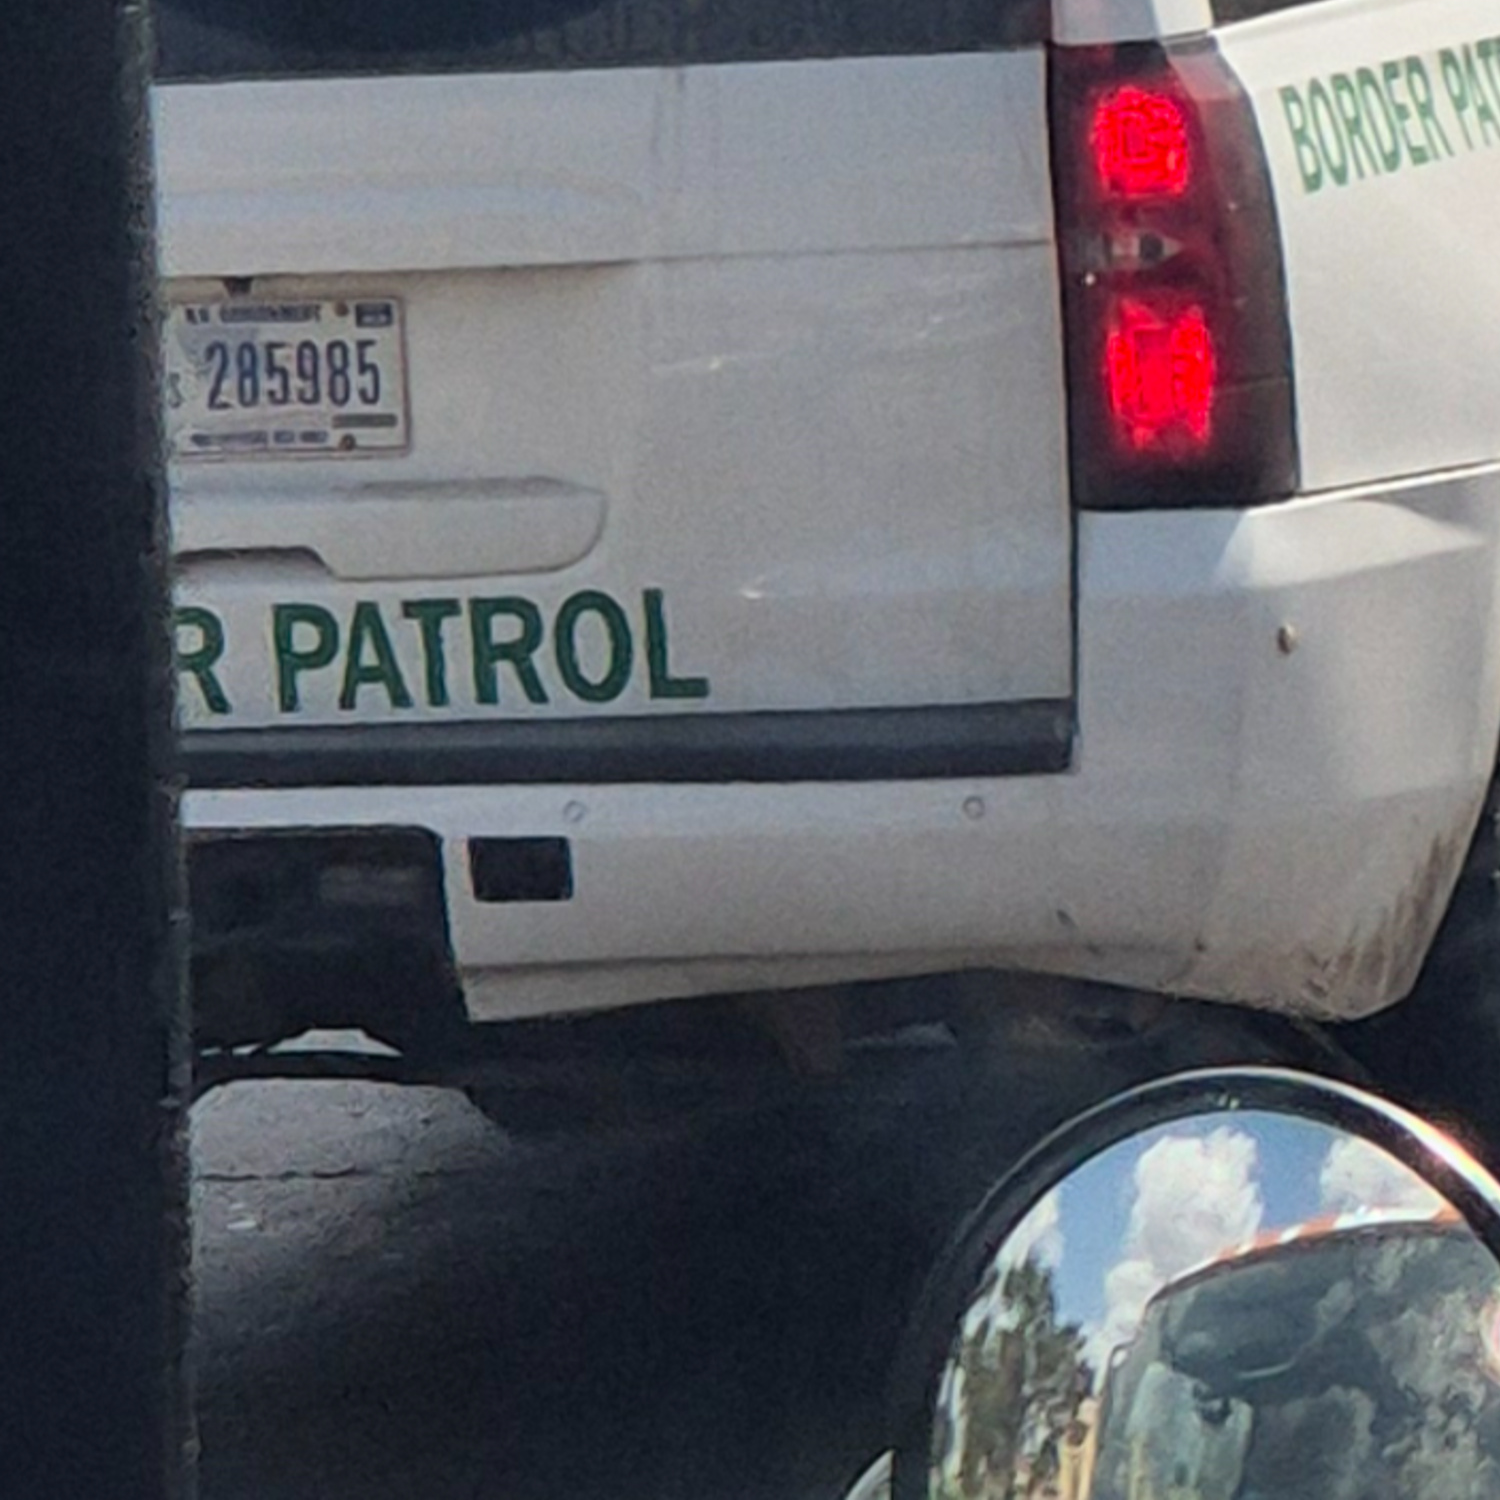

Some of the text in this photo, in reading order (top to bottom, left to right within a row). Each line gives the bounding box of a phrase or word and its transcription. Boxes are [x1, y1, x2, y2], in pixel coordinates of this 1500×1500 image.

[1278, 55, 1453, 194] BORDER
[205, 339, 381, 410] 285985
[272, 588, 709, 713] PATROL
